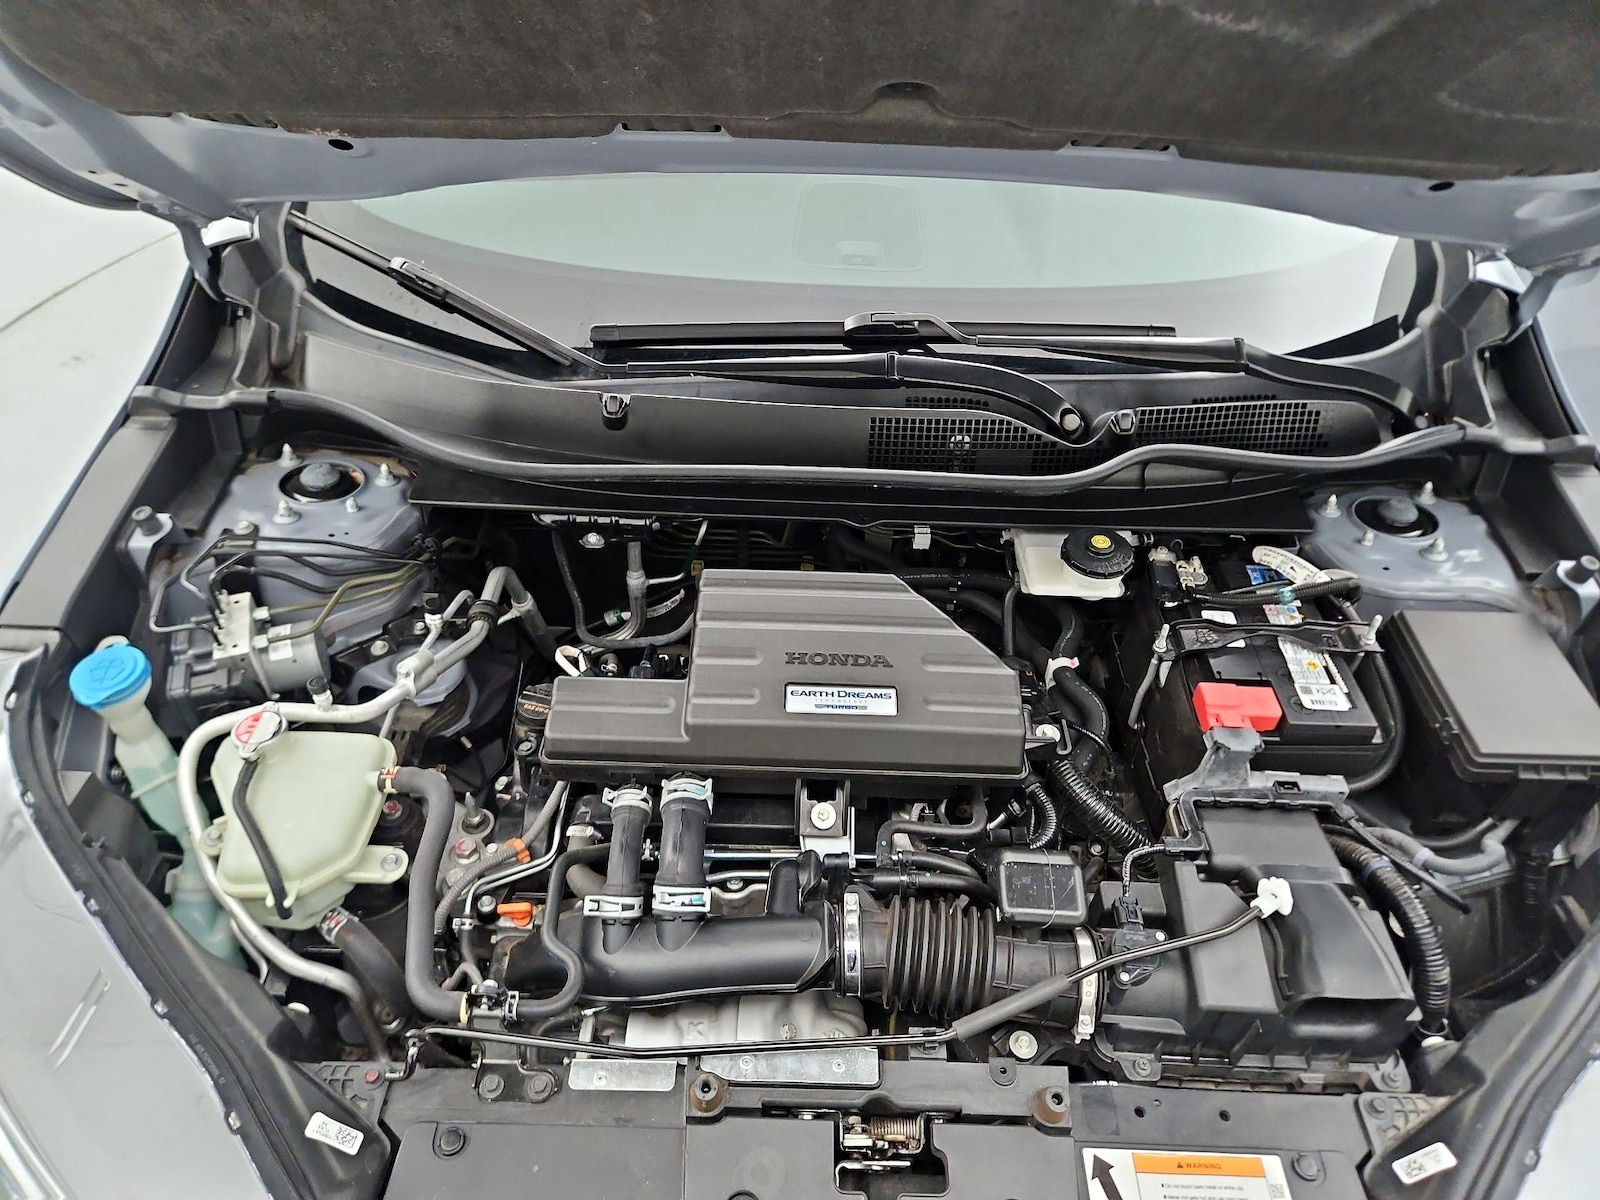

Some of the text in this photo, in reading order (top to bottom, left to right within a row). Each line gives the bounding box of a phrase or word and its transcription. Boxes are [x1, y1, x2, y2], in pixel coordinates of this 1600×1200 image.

[784, 651, 894, 668] HONDA
[790, 689, 835, 698] EARTH
[1186, 1162, 1222, 1170] WARNING
